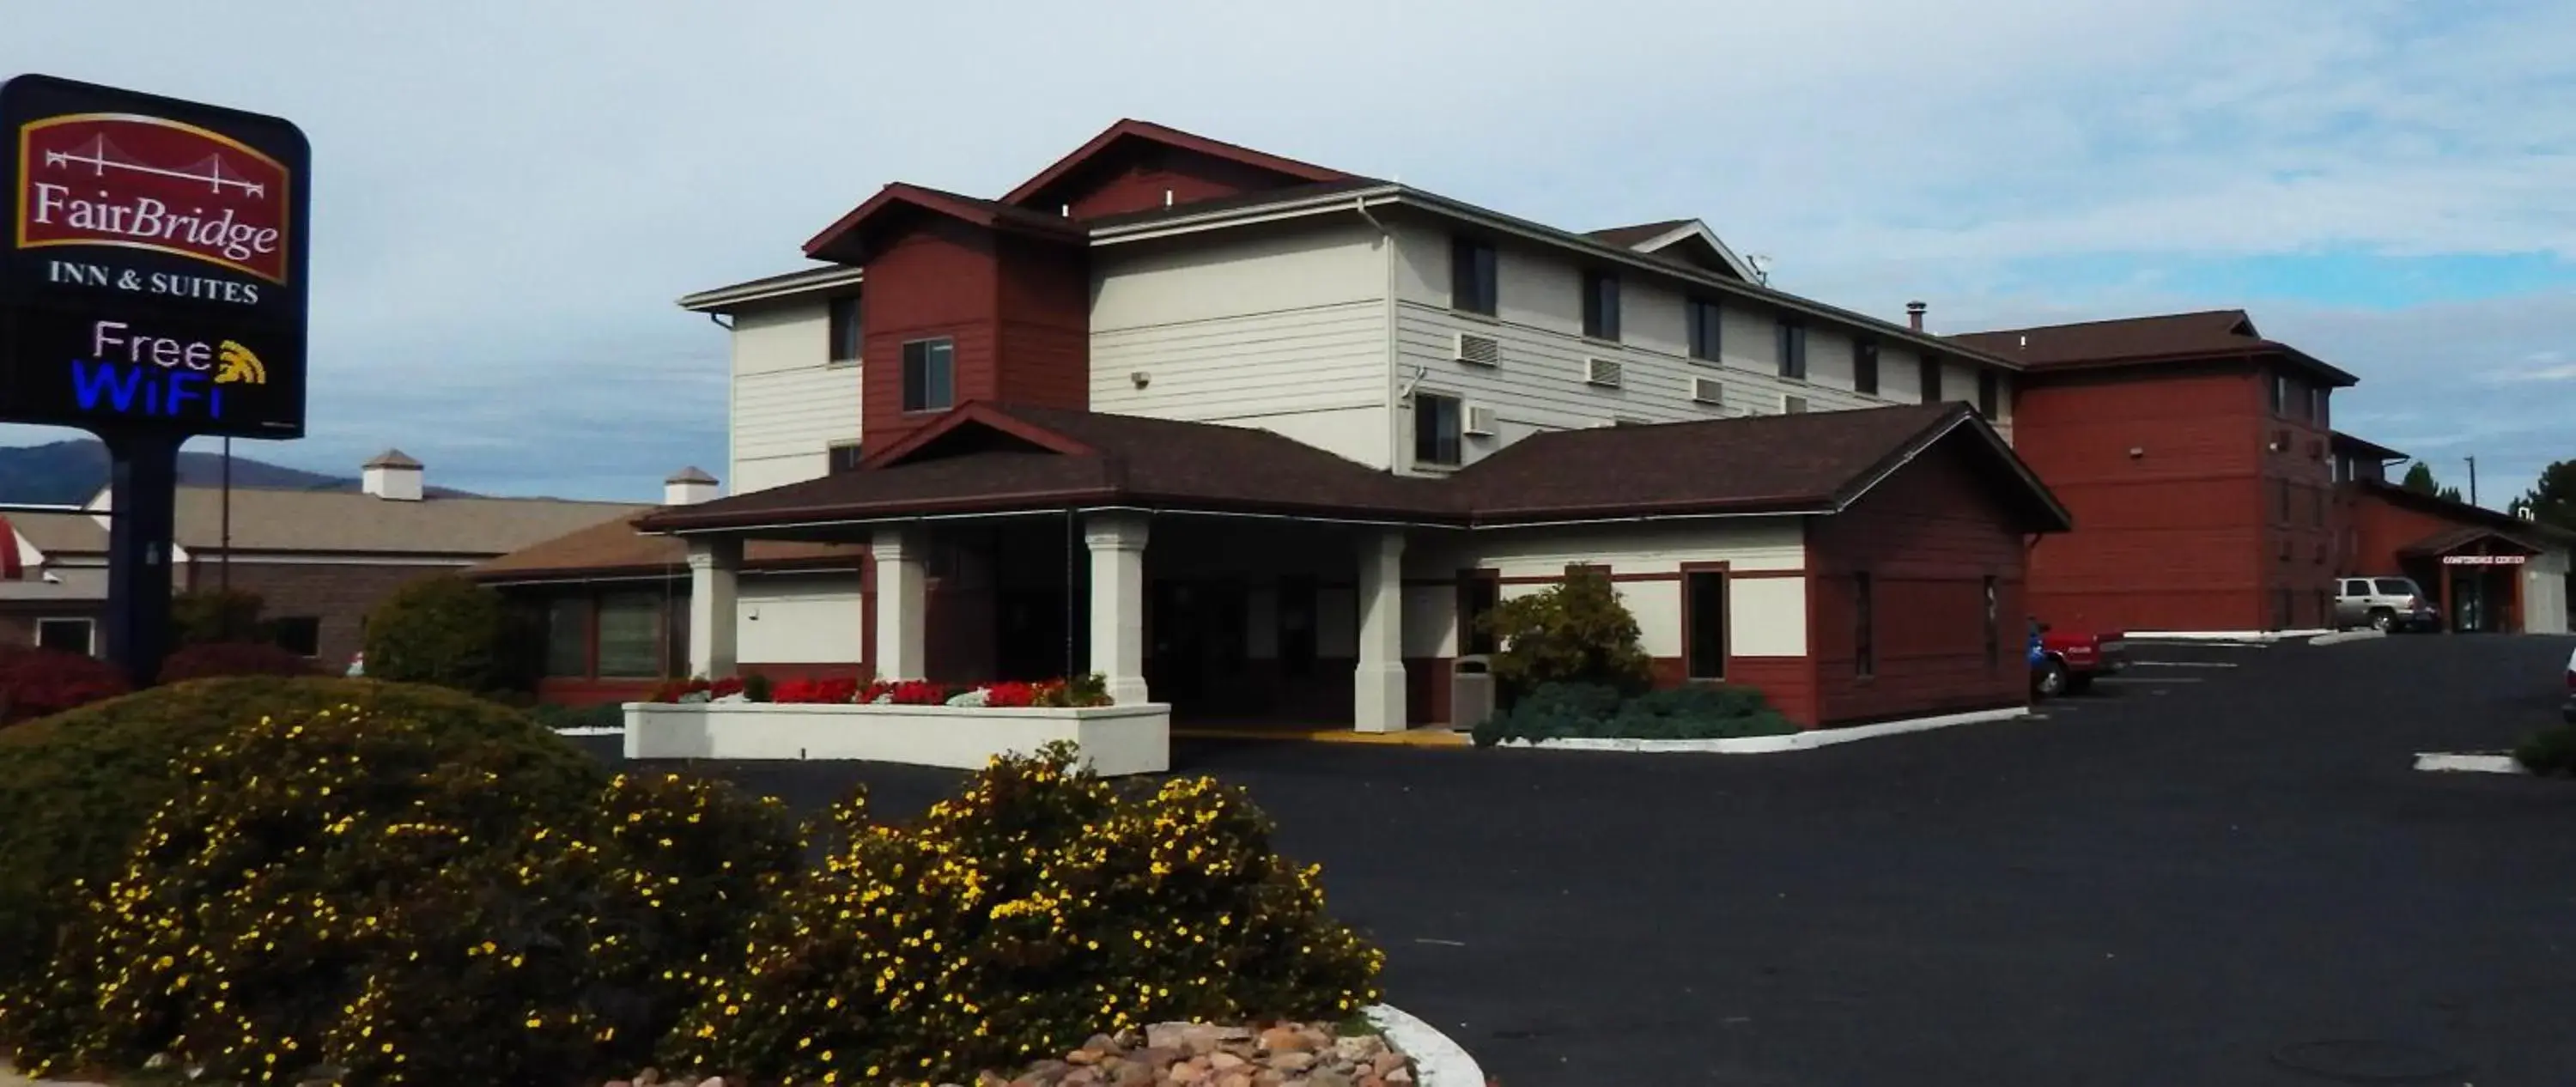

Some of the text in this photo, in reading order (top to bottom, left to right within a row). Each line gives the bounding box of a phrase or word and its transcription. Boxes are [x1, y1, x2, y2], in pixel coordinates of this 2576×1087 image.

[34, 182, 278, 260] FairBridge
[48, 260, 258, 305] INN & SUITES
[93, 320, 212, 370] Free
[71, 359, 222, 419] WiFi
